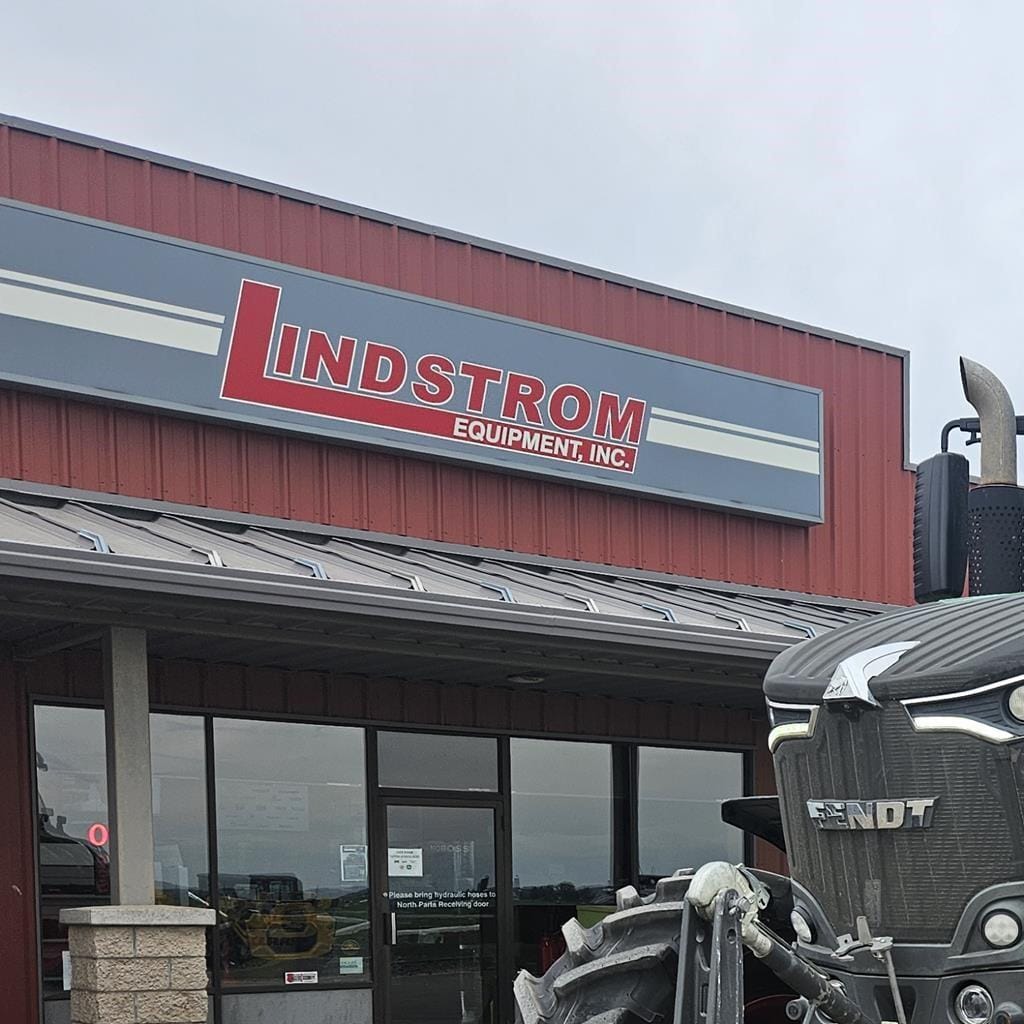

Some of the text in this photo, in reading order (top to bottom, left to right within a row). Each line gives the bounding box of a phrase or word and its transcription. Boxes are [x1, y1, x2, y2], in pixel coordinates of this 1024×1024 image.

[220, 278, 647, 447] LINDSTROM
[453, 416, 631, 469] EQUIPMENT, INC.
[806, 798, 936, 830] FENDT
[388, 891, 413, 899] Please
[414, 891, 433, 900] bring
[434, 891, 466, 900] hydraulic
[438, 901, 472, 909] Receiving
